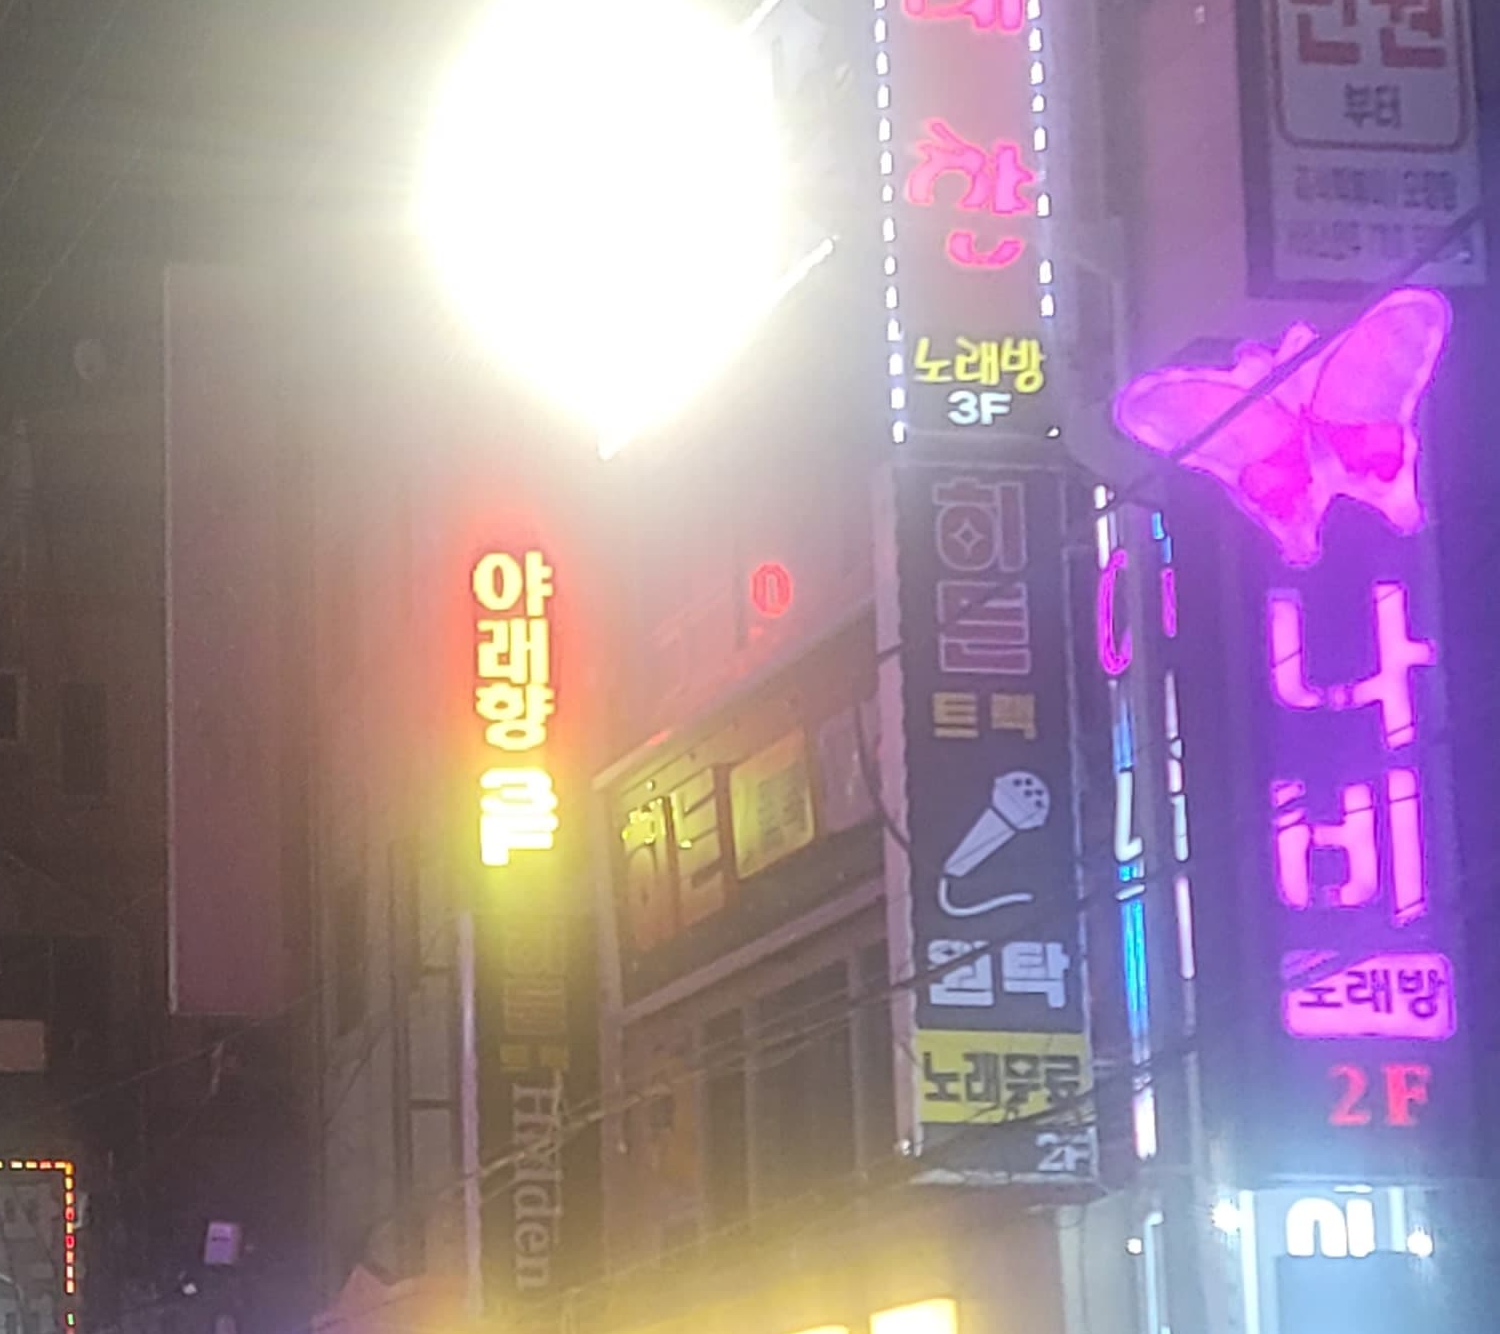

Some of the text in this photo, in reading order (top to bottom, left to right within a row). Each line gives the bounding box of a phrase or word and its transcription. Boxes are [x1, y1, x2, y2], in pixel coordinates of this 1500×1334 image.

[914, 335, 1046, 394] 노래방
[946, 388, 1015, 427] 3F
[472, 549, 556, 752] 야래향
[1268, 579, 1437, 929] 나비
[927, 937, 1071, 1009] 원탁
[1298, 967, 1450, 1019] 노래방
[1328, 1064, 1432, 1127] 2F
